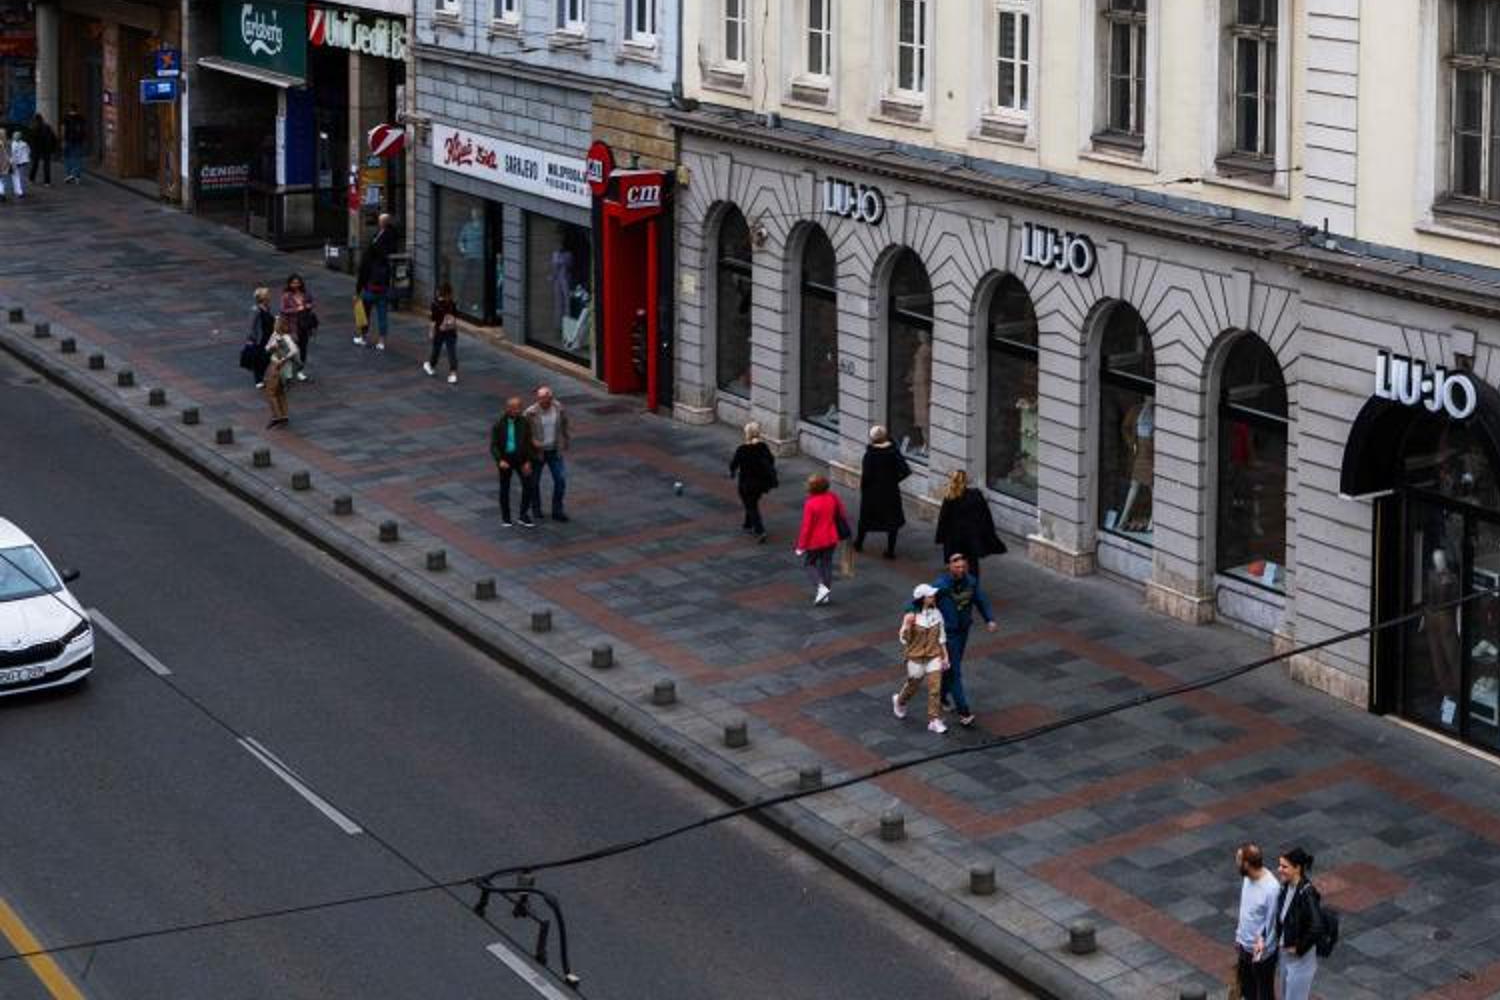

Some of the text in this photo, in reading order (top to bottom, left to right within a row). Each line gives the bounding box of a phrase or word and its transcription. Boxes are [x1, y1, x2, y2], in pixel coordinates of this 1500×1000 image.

[241, 3, 284, 55] Carlsberg
[325, 9, 392, 58] UniCredit
[505, 154, 539, 181] SARAJEVO
[627, 184, 661, 202] cm
